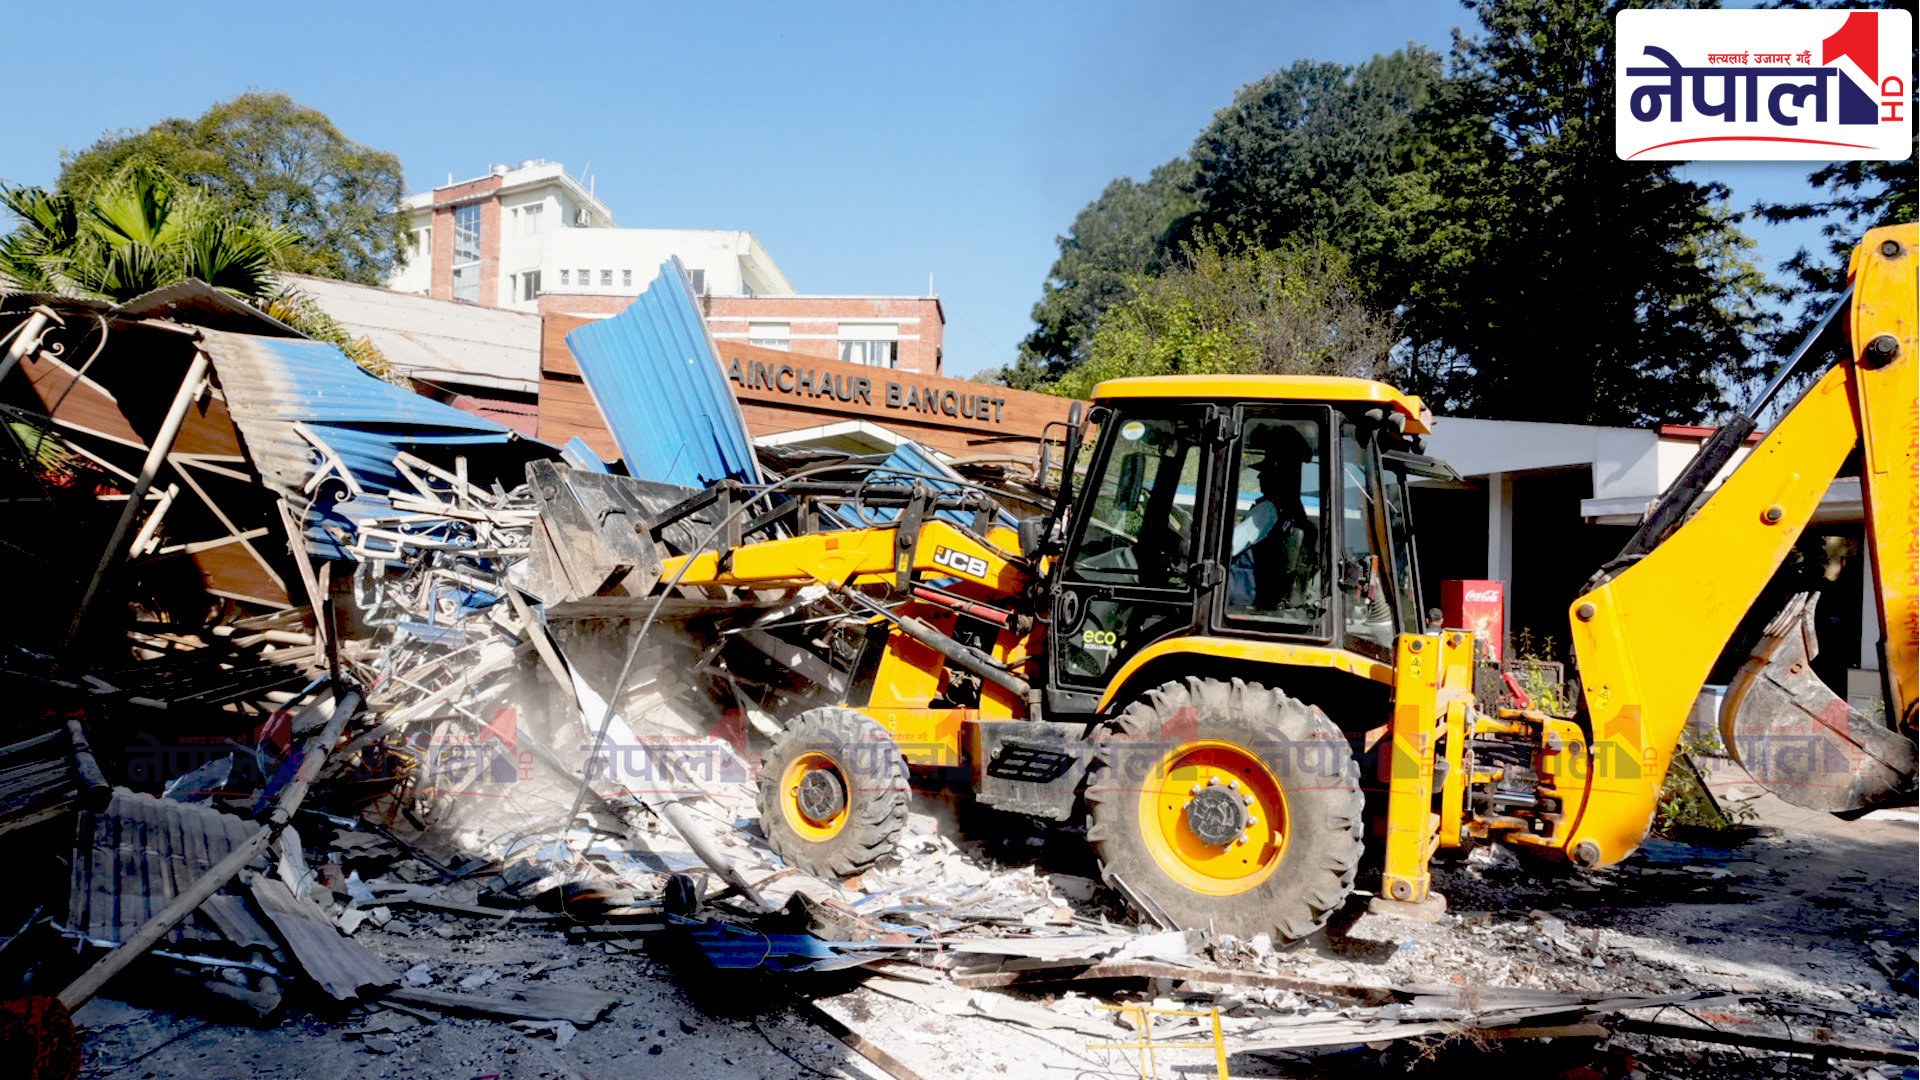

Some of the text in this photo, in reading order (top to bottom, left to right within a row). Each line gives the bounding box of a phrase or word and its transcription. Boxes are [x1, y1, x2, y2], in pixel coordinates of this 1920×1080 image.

[886, 381, 1006, 423] BANQUET
[934, 548, 988, 578] JCB
[1083, 630, 1117, 645] eco
